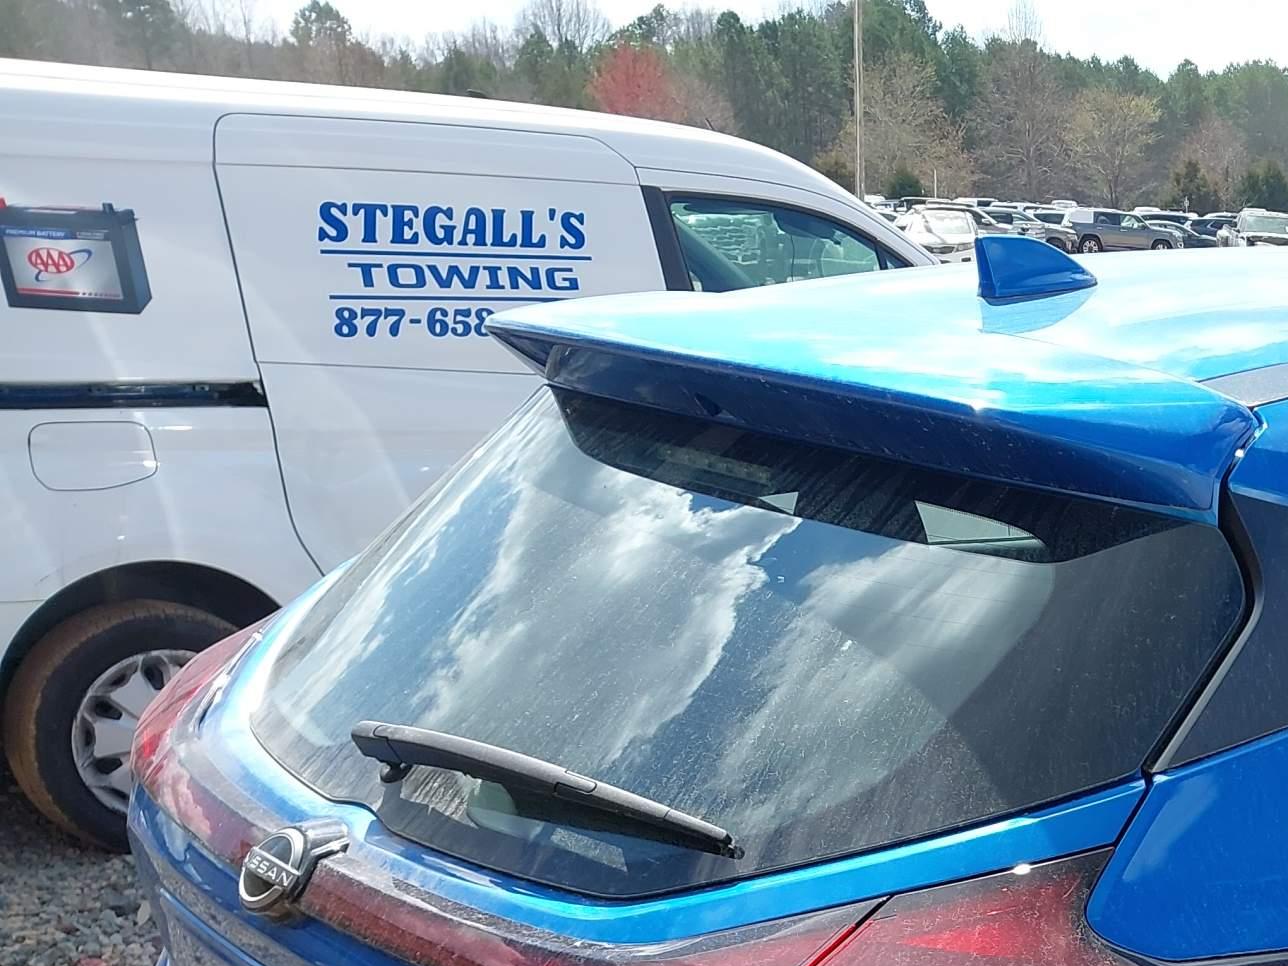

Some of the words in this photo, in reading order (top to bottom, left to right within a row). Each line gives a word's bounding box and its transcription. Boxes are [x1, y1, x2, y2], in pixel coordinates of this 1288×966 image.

[318, 201, 586, 250] STEGALL'S
[33, 249, 72, 273] AAA
[347, 263, 579, 291] TOWING
